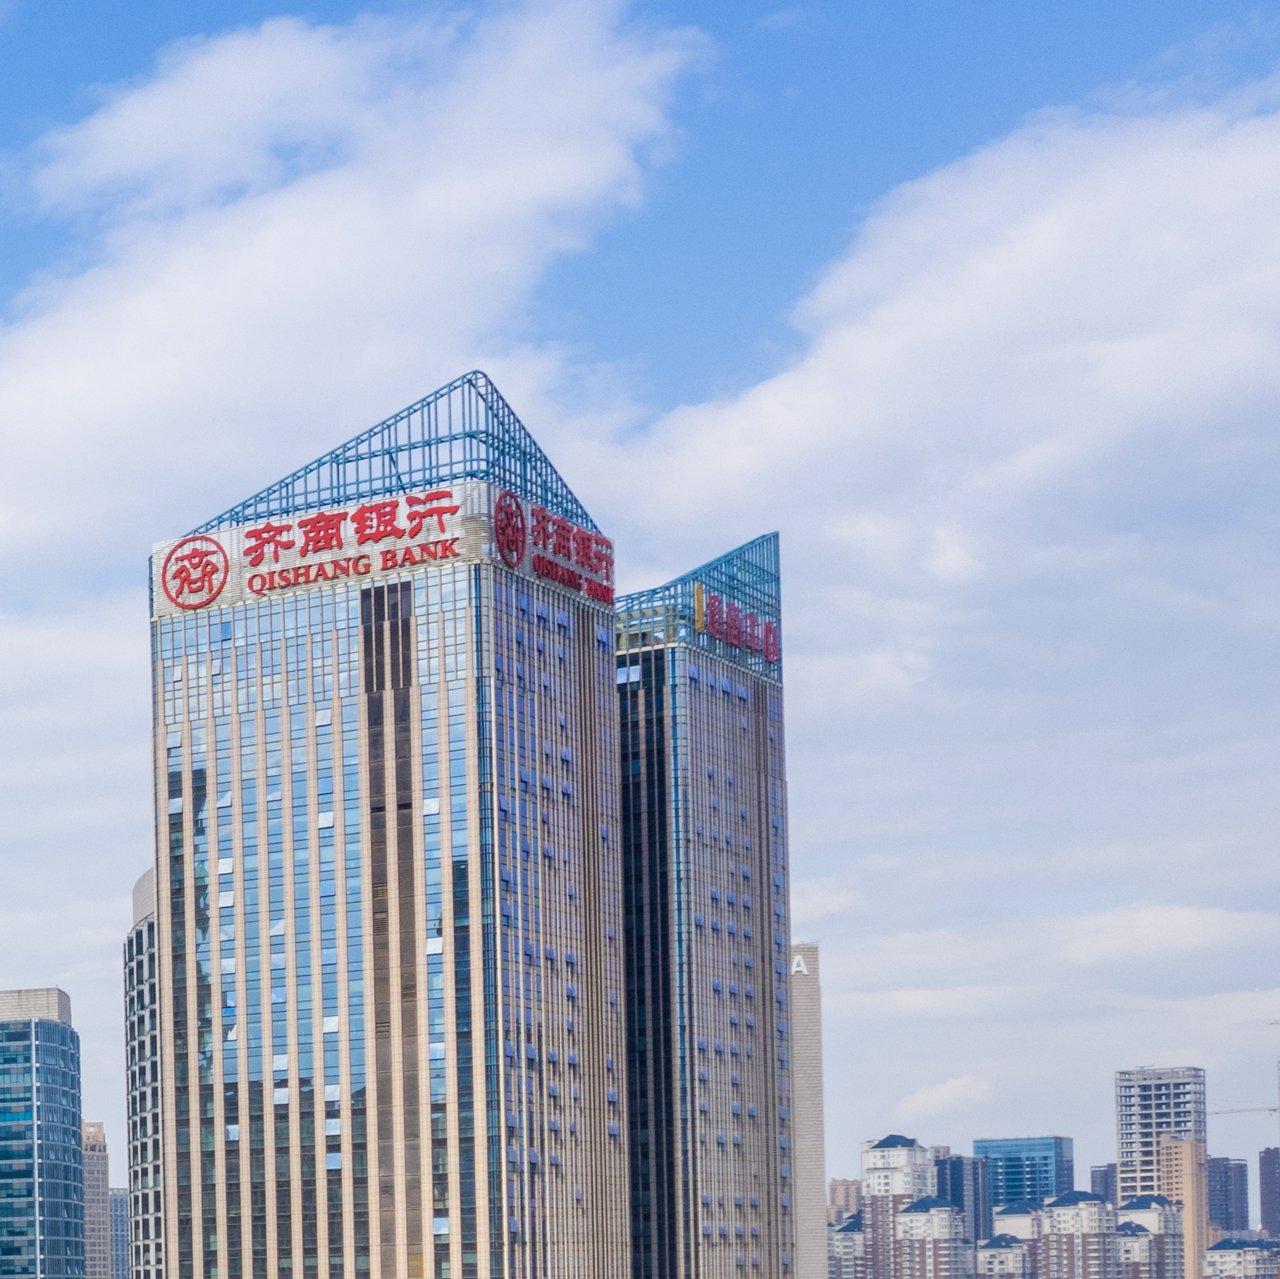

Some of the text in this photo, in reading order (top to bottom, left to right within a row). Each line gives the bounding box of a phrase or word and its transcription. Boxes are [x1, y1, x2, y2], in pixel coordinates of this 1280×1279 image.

[243, 490, 460, 567] 齐商银行
[246, 537, 461, 597] QISHANG BANK
